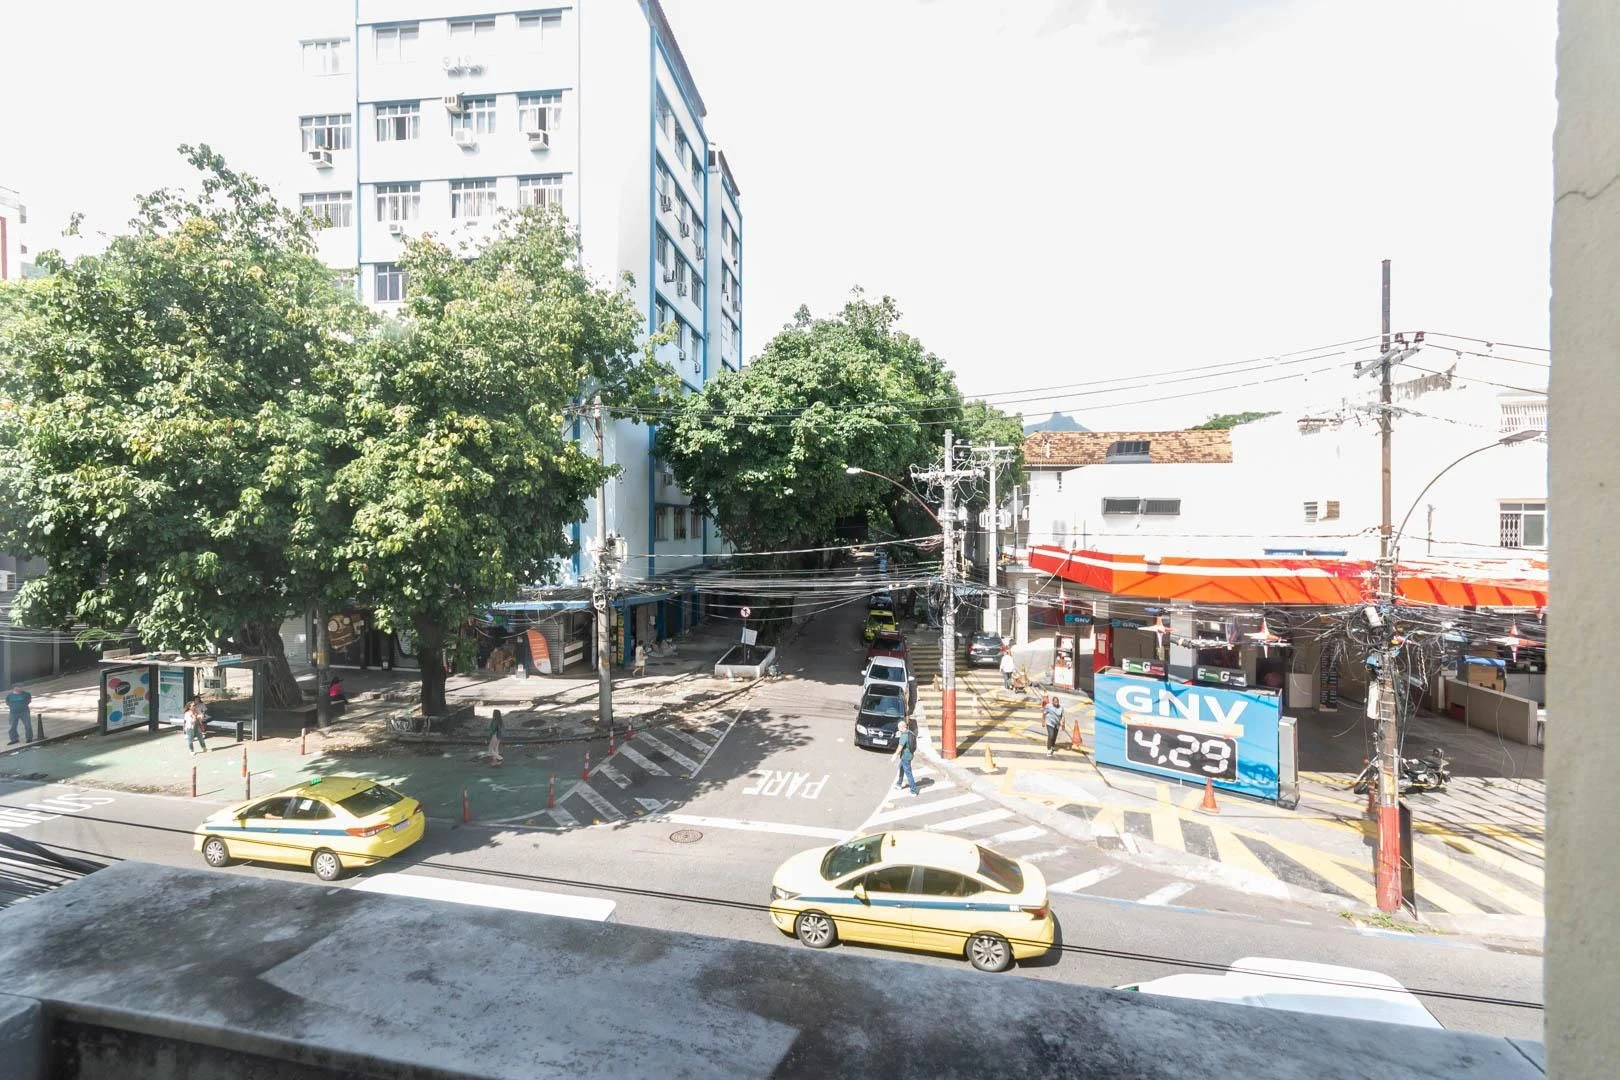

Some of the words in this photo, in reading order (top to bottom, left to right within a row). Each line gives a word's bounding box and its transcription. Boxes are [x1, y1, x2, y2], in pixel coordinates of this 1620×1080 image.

[1220, 671, 1230, 682] G
[1115, 685, 1249, 725] GNV
[1134, 729, 1231, 774] 4,29
[741, 769, 830, 800] PARE
